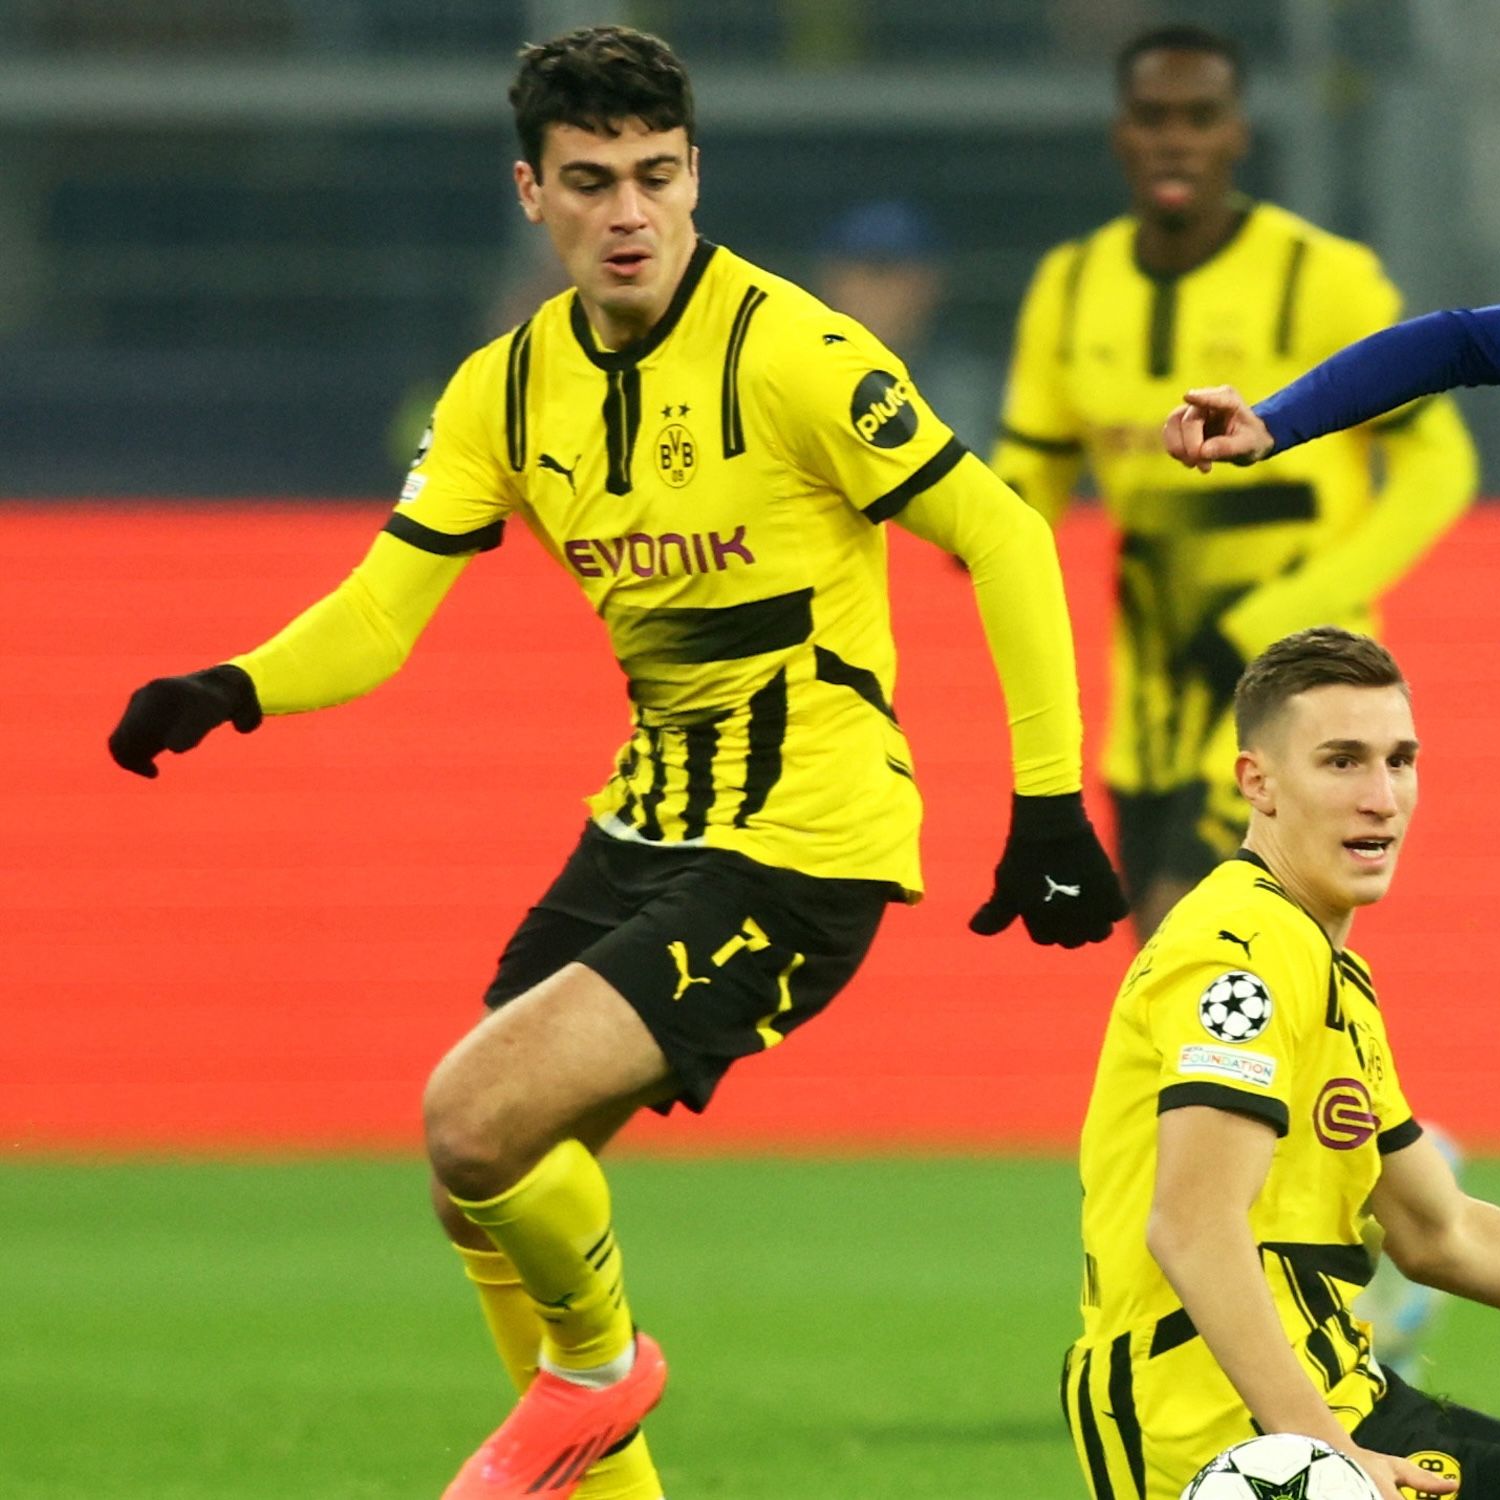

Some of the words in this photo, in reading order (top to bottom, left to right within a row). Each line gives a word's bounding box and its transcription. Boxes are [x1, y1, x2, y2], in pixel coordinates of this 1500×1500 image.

[660, 430, 694, 470] BVB
[564, 525, 756, 578] EVONIK
[711, 916, 771, 967] 7
[1182, 1053, 1273, 1077] FOUNDATION
